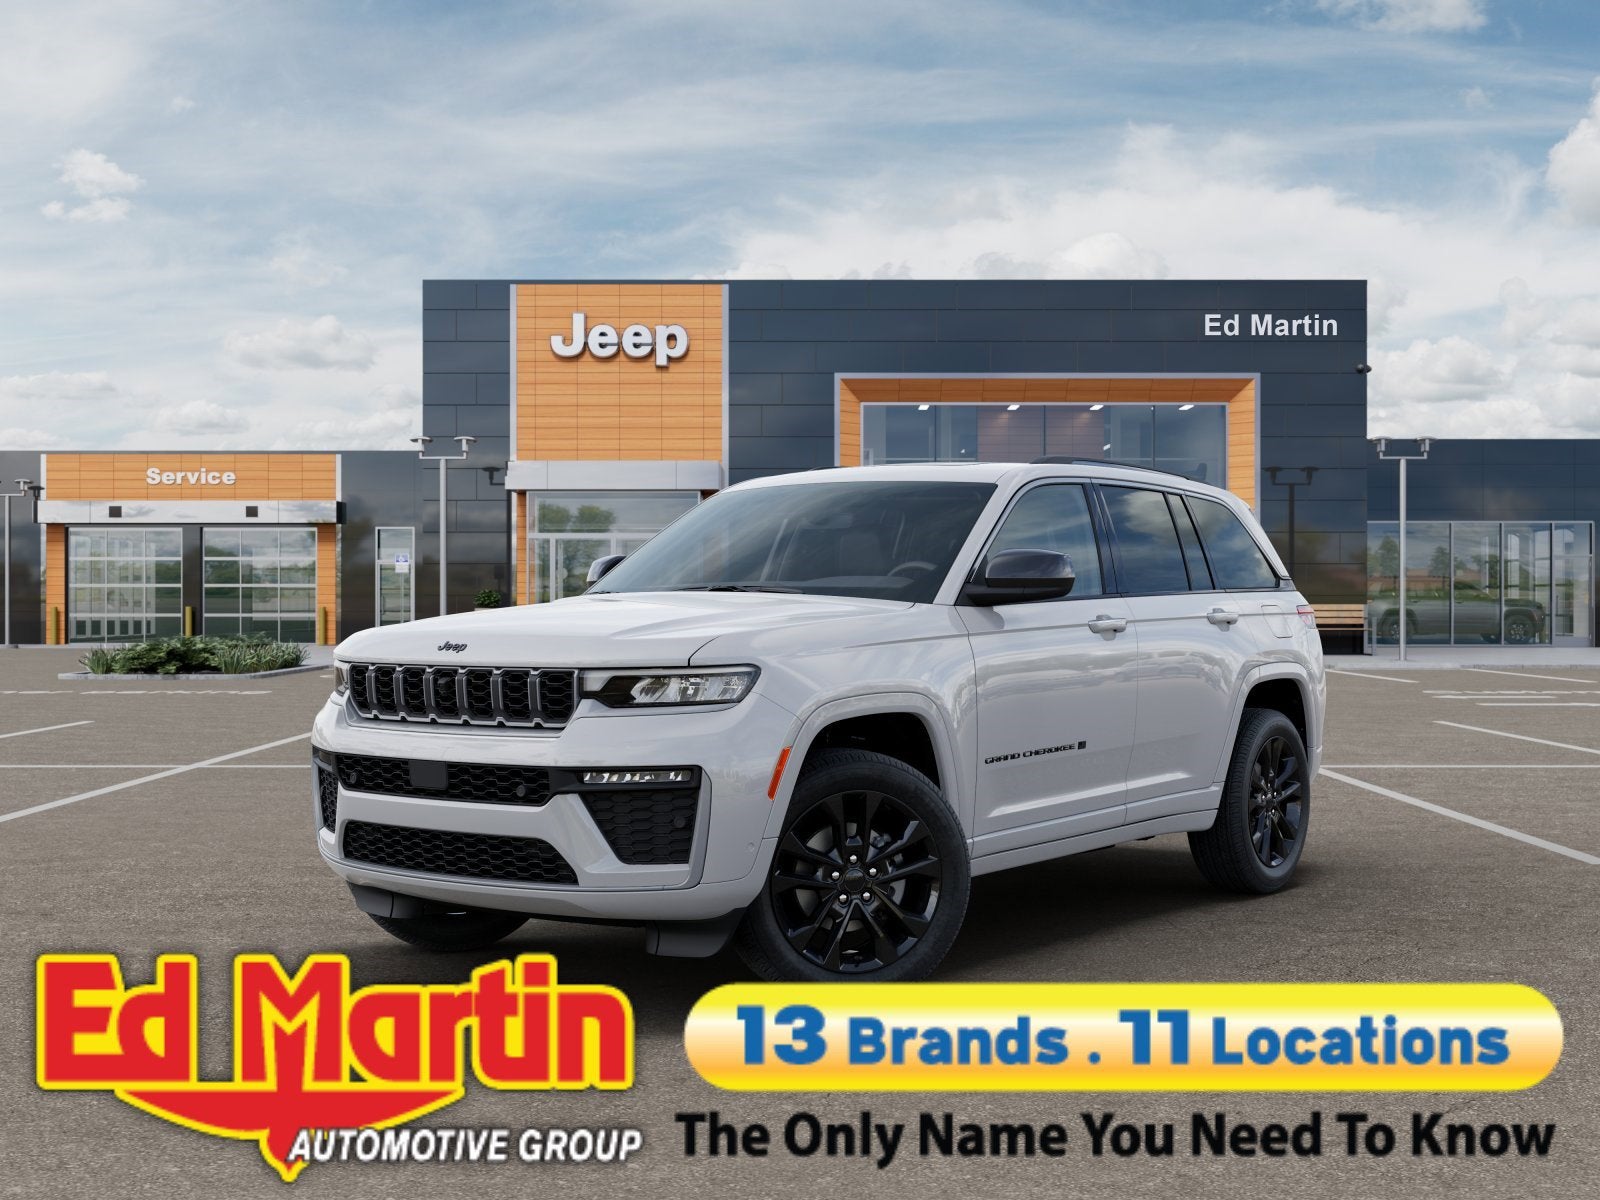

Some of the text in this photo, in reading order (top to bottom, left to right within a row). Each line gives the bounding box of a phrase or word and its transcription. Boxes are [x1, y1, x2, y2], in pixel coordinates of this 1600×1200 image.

[1204, 313, 1338, 336] Ed Martin
[550, 312, 690, 368] Jeep
[146, 467, 237, 485] Service
[437, 641, 468, 653] Jeep
[984, 743, 1076, 765] GRAND CHEROKEE
